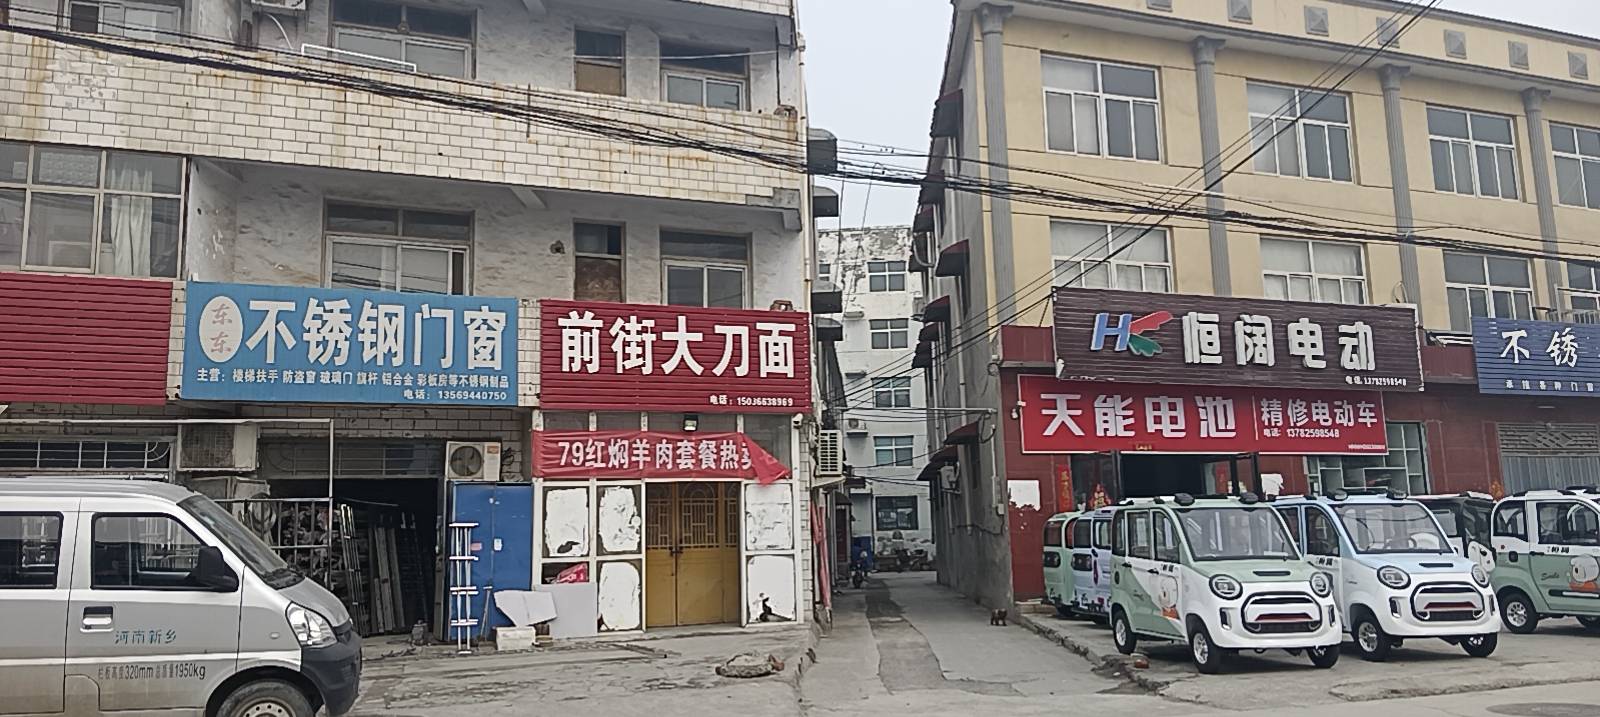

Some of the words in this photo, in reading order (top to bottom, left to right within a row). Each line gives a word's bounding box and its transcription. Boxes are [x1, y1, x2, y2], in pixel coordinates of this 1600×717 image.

[209, 303, 233, 353] 东东
[245, 297, 507, 371] 不锈钢门窗
[558, 310, 796, 378] 前街大刀面
[1182, 311, 1376, 371] 恒阔电动
[1500, 327, 1579, 368] 不锈
[232, 368, 279, 384] 楼梯扶手
[282, 369, 317, 384] 防盗窗
[319, 370, 353, 385] 玻璃门
[356, 371, 378, 386] 旗杆
[381, 372, 414, 387] 铝合金
[417, 373, 509, 388] 彩板房等不锈钢制品
[438, 390, 507, 401] 13569440750
[1040, 393, 1237, 439] 天能电池
[1260, 398, 1378, 428] 精修电动车
[1286, 428, 1340, 438] 13782598548
[115, 629, 177, 645] 河南新乡
